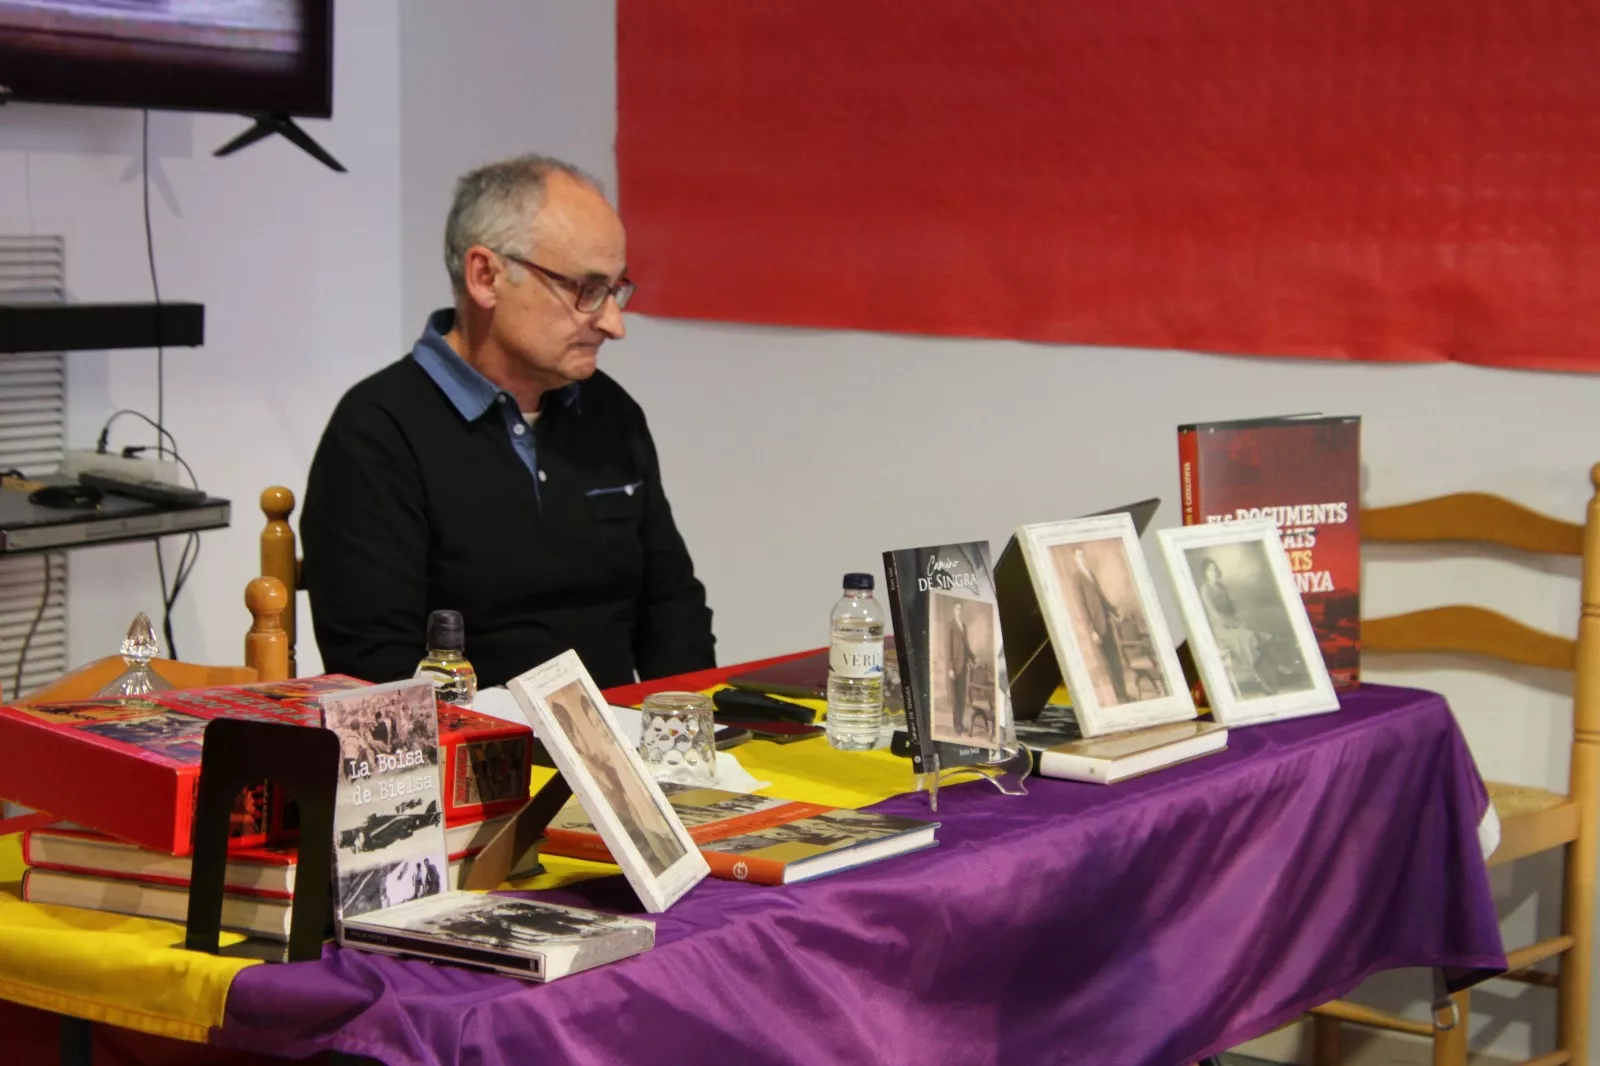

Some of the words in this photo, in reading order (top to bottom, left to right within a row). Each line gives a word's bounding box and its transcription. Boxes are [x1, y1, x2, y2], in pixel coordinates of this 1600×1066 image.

[1236, 502, 1348, 527] DOCUMENTS
[918, 577, 933, 592] DE
[936, 573, 976, 590] SINGRA
[350, 760, 371, 779] La
[376, 748, 424, 773] Bolsa
[353, 785, 372, 806] de
[379, 774, 434, 800] Bielsa
